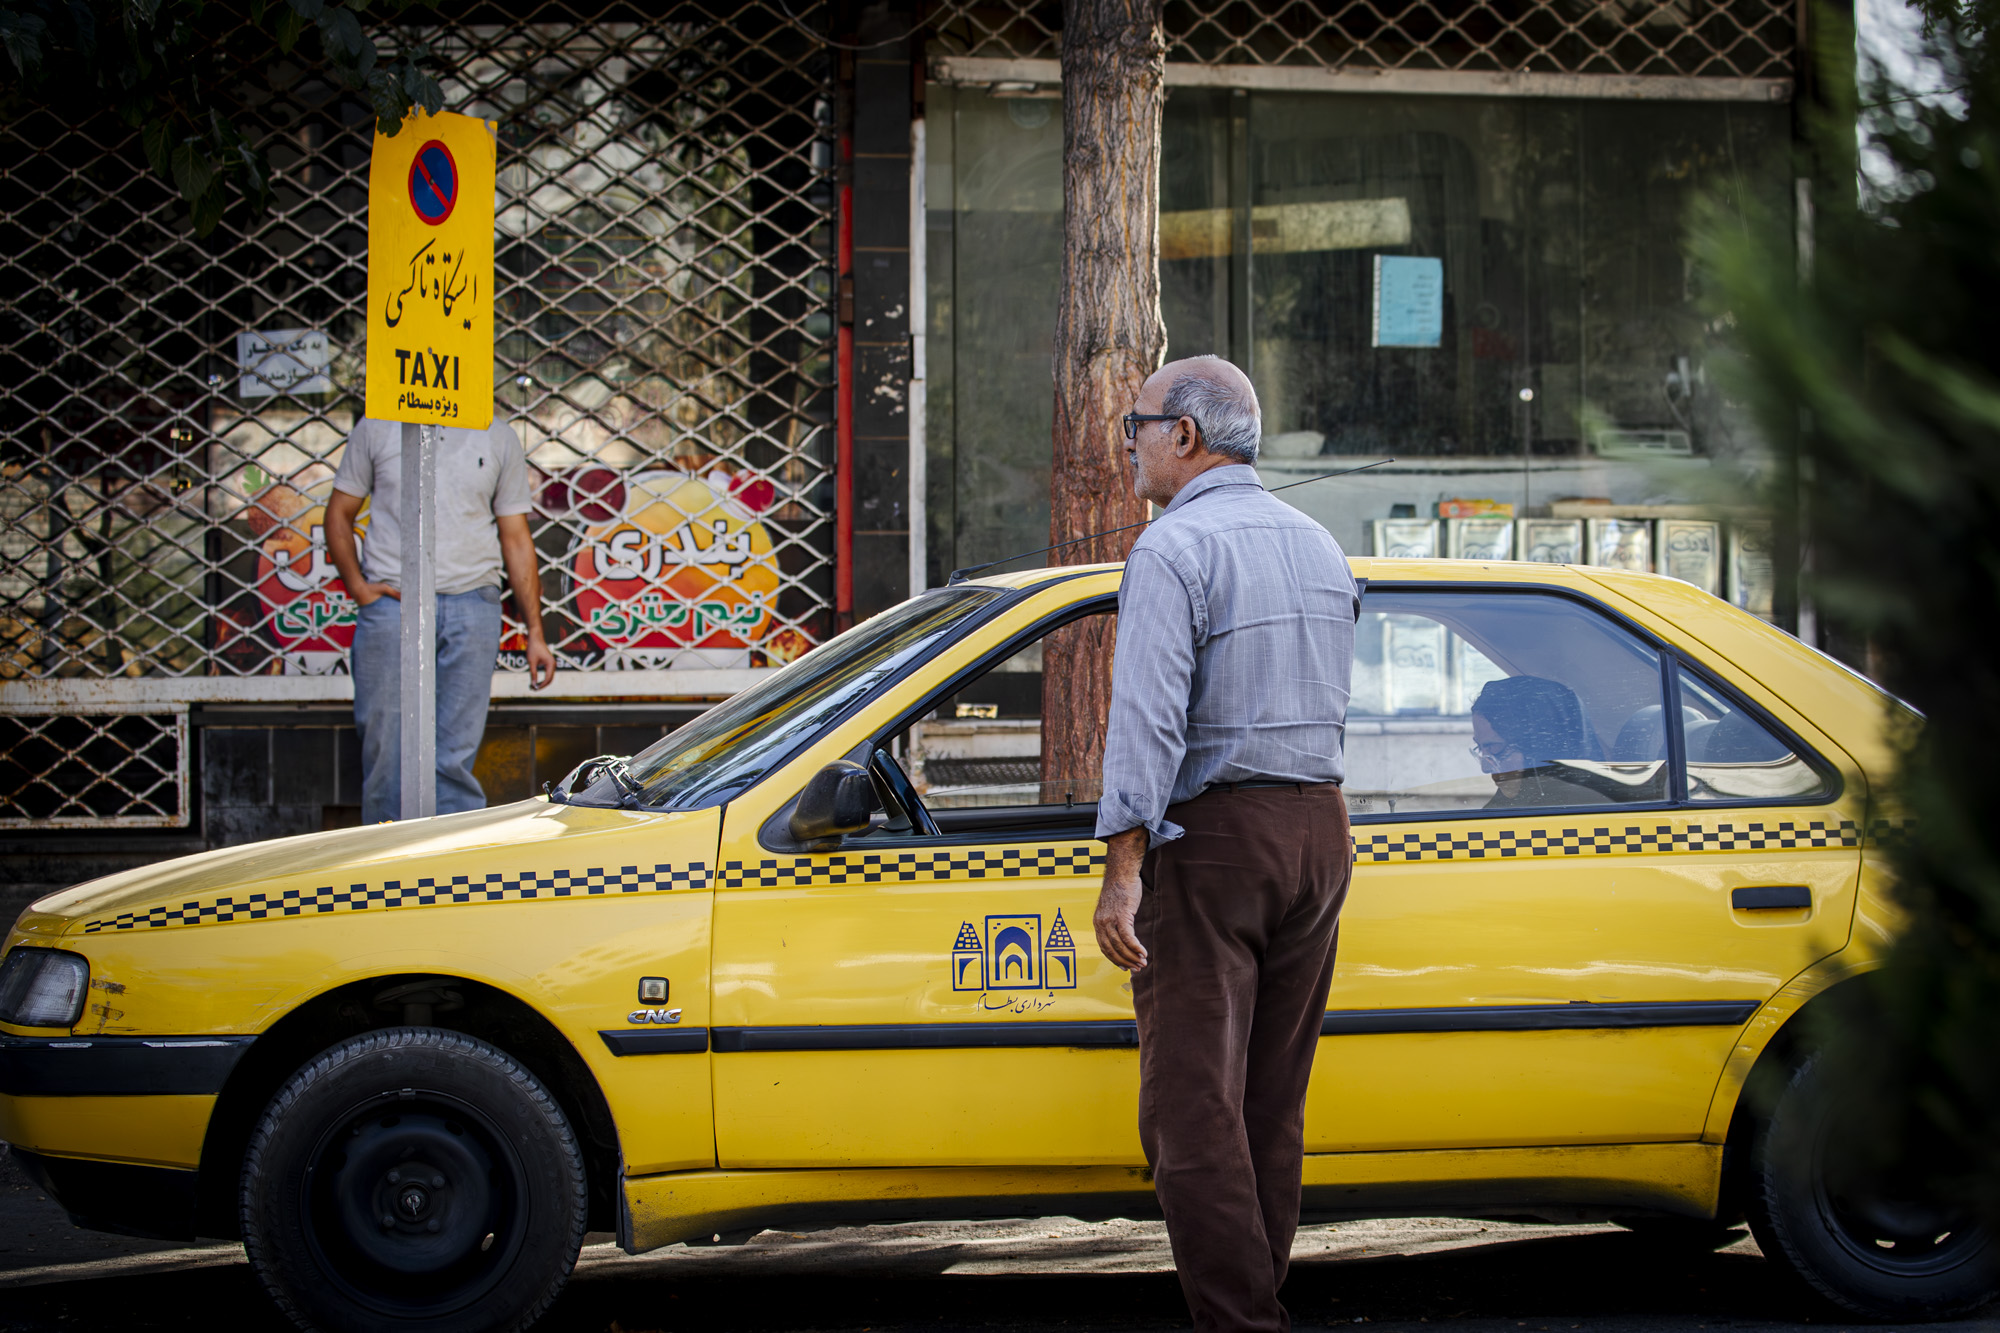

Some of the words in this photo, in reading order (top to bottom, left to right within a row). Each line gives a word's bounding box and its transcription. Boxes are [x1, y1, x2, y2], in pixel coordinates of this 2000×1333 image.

[385, 238, 436, 328] تاکسی
[434, 247, 477, 330] ایستگاه
[395, 348, 459, 391] TAXI
[398, 391, 434, 415] بسطام
[435, 396, 459, 418] ویژه
[594, 519, 751, 583] بندری
[590, 594, 690, 640] متری
[695, 592, 762, 640] نیم
[627, 1008, 682, 1025] CNG
